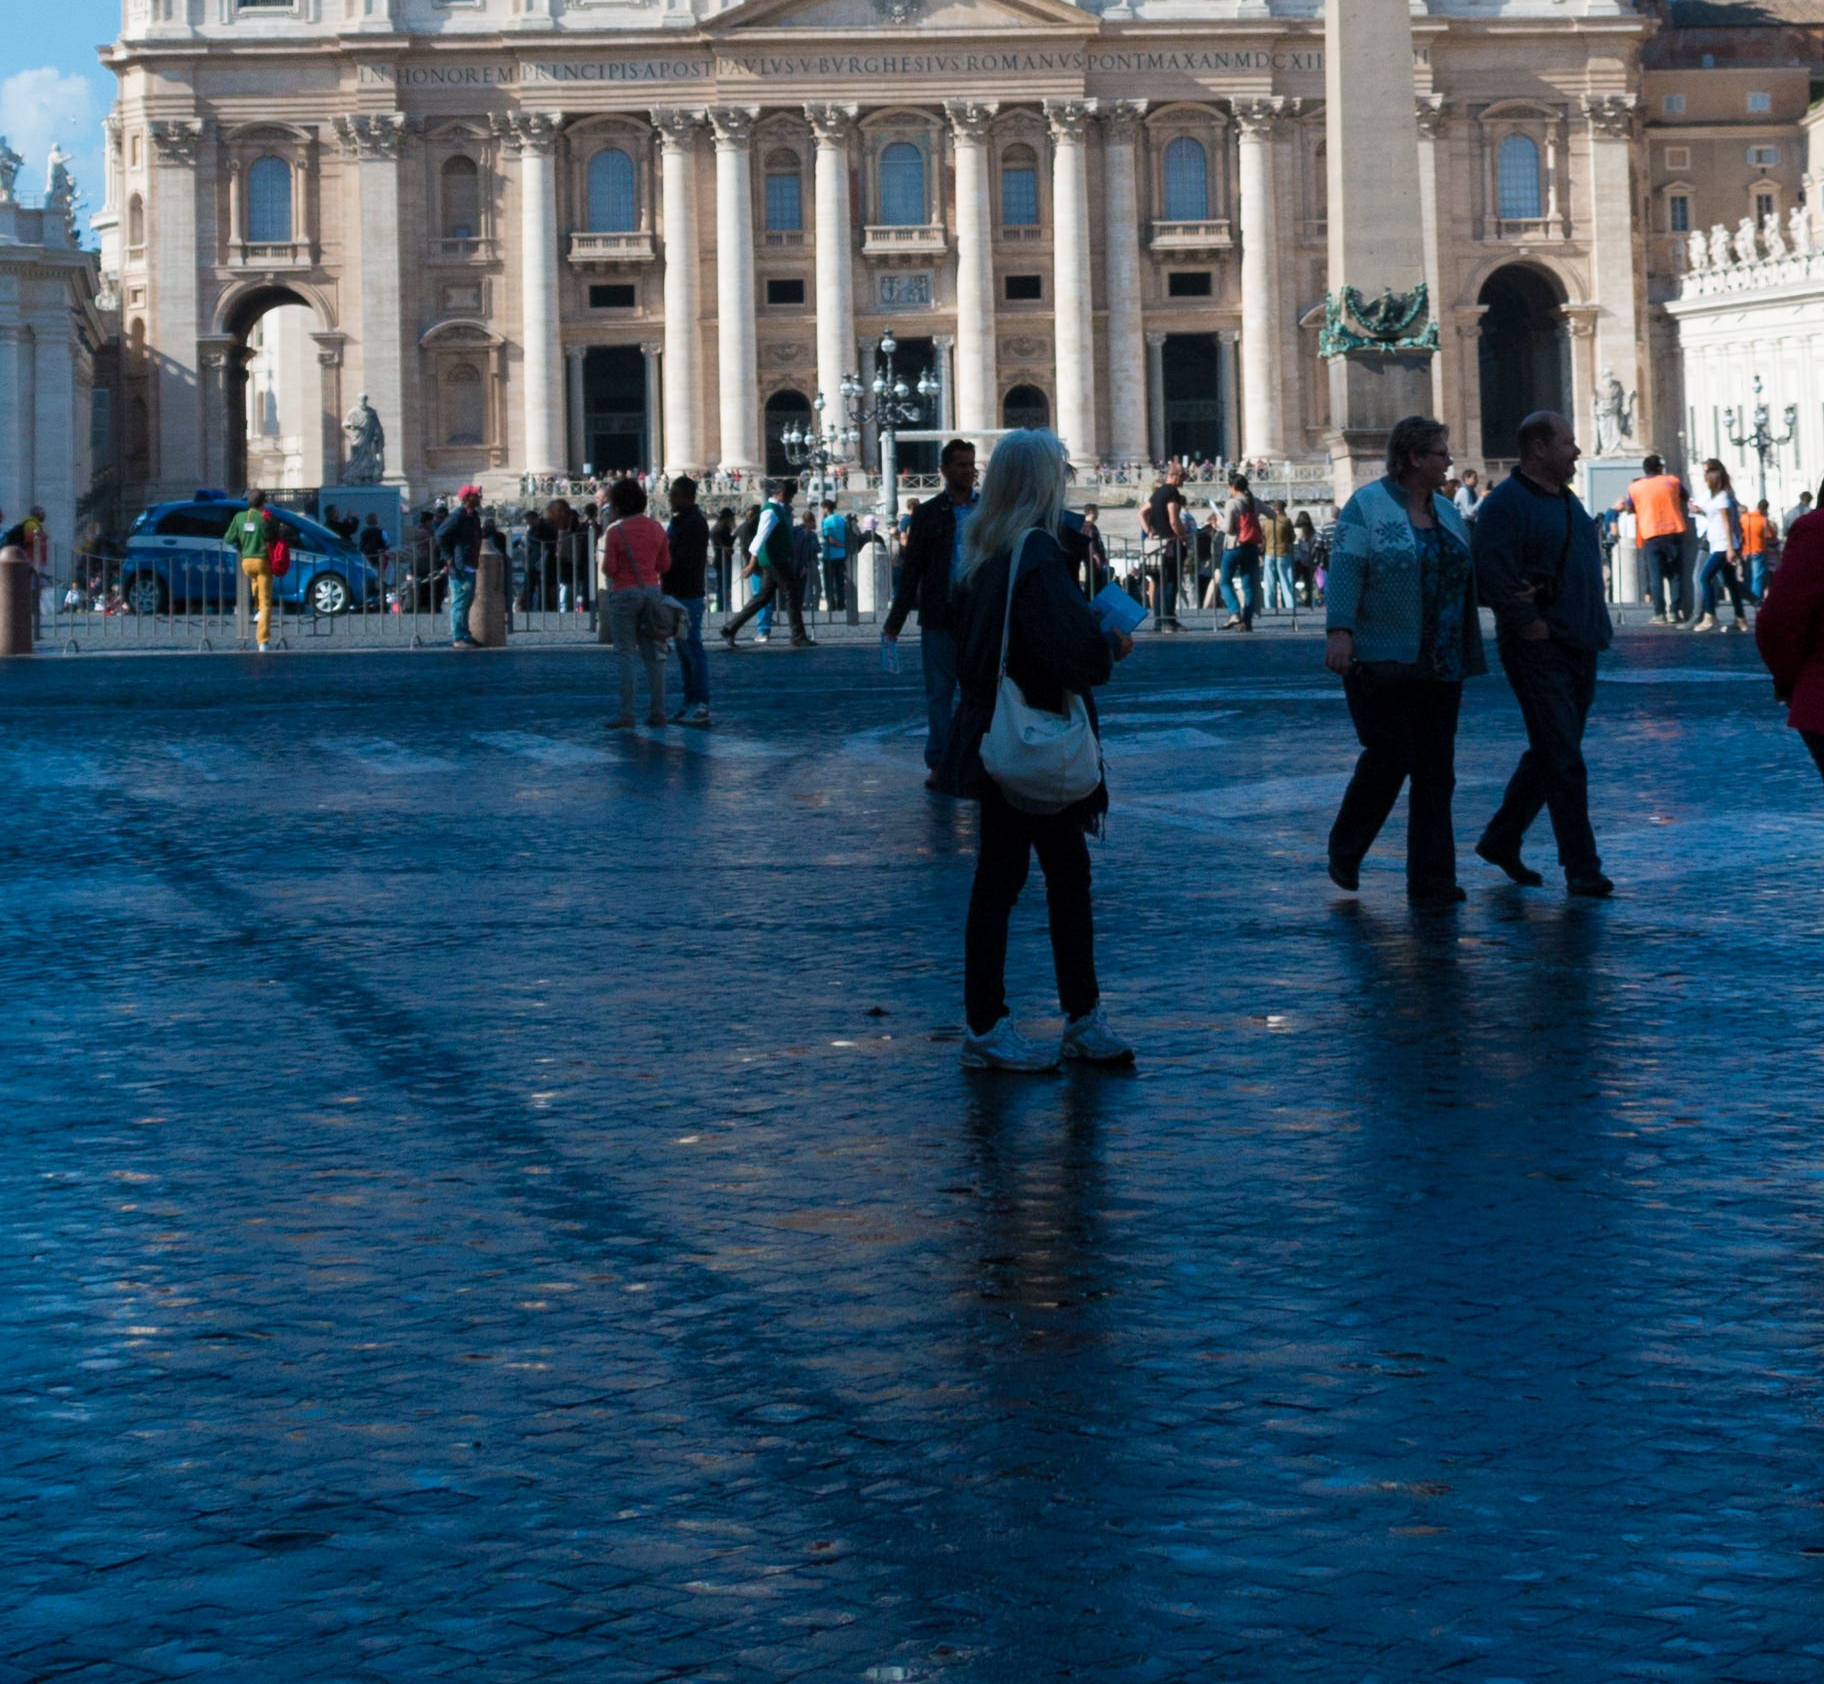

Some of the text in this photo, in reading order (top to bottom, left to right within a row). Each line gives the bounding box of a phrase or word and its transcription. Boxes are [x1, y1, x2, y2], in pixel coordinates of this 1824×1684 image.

[360, 66, 386, 83] IN
[396, 67, 514, 85] HONOREM
[522, 62, 639, 81] PRINCIPIS
[644, 60, 716, 78] APOST
[719, 57, 794, 75] PAVLVS
[799, 58, 813, 74] V
[819, 55, 961, 73] BVRGHESIVS
[966, 53, 1083, 72] ROMANVS
